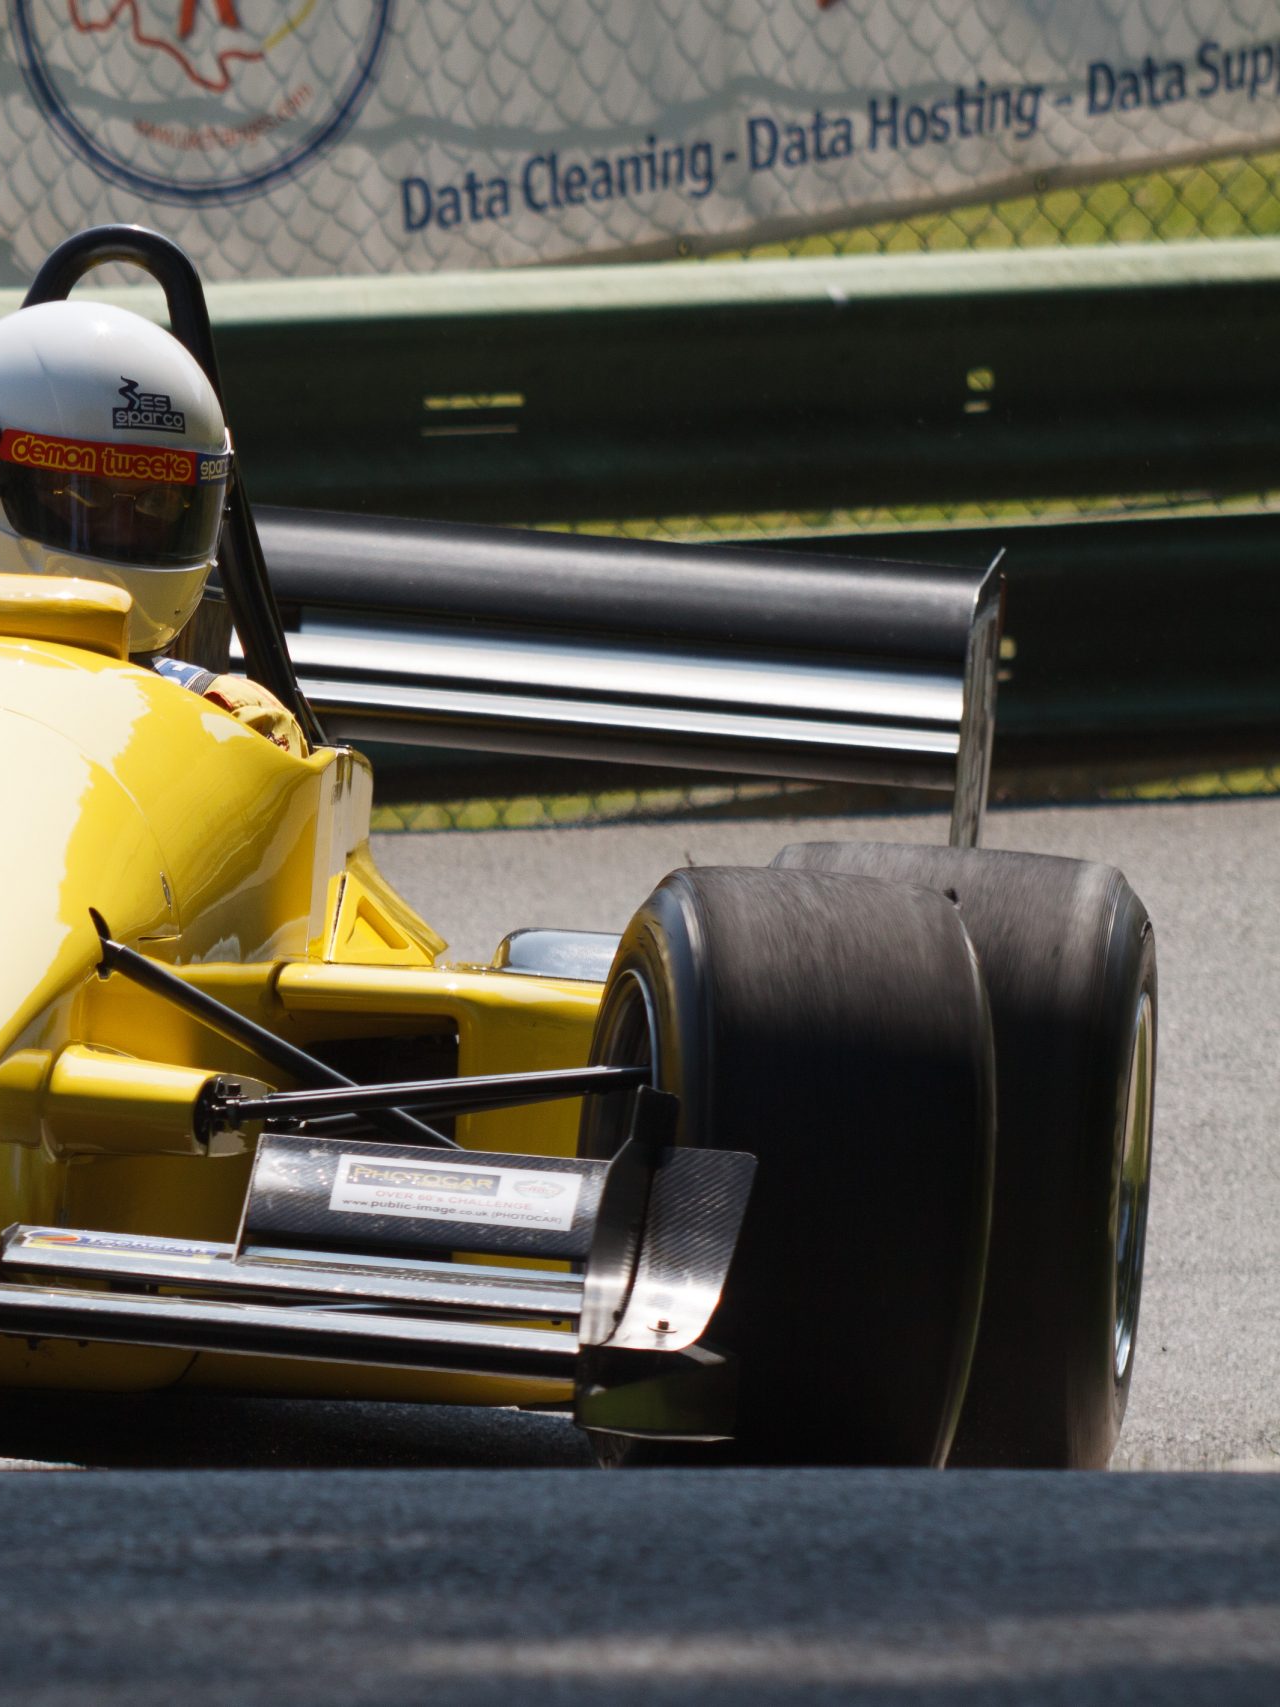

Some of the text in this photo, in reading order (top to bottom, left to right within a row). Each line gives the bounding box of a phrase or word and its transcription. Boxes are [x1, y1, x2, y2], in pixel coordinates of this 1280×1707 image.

[401, 171, 510, 234] Data
[523, 135, 714, 213] Cleaning
[747, 110, 852, 172] Data
[869, 79, 1043, 150] Hosting
[1088, 55, 1186, 115] Data
[1197, 40, 1280, 102] Sup
[115, 410, 184, 430] sparco
[11, 435, 96, 473] demon
[101, 447, 192, 482] tweeks
[354, 1166, 493, 1190] PHOTOCAR
[375, 1190, 414, 1200] OVER
[447, 1196, 534, 1211] CHALLENGE
